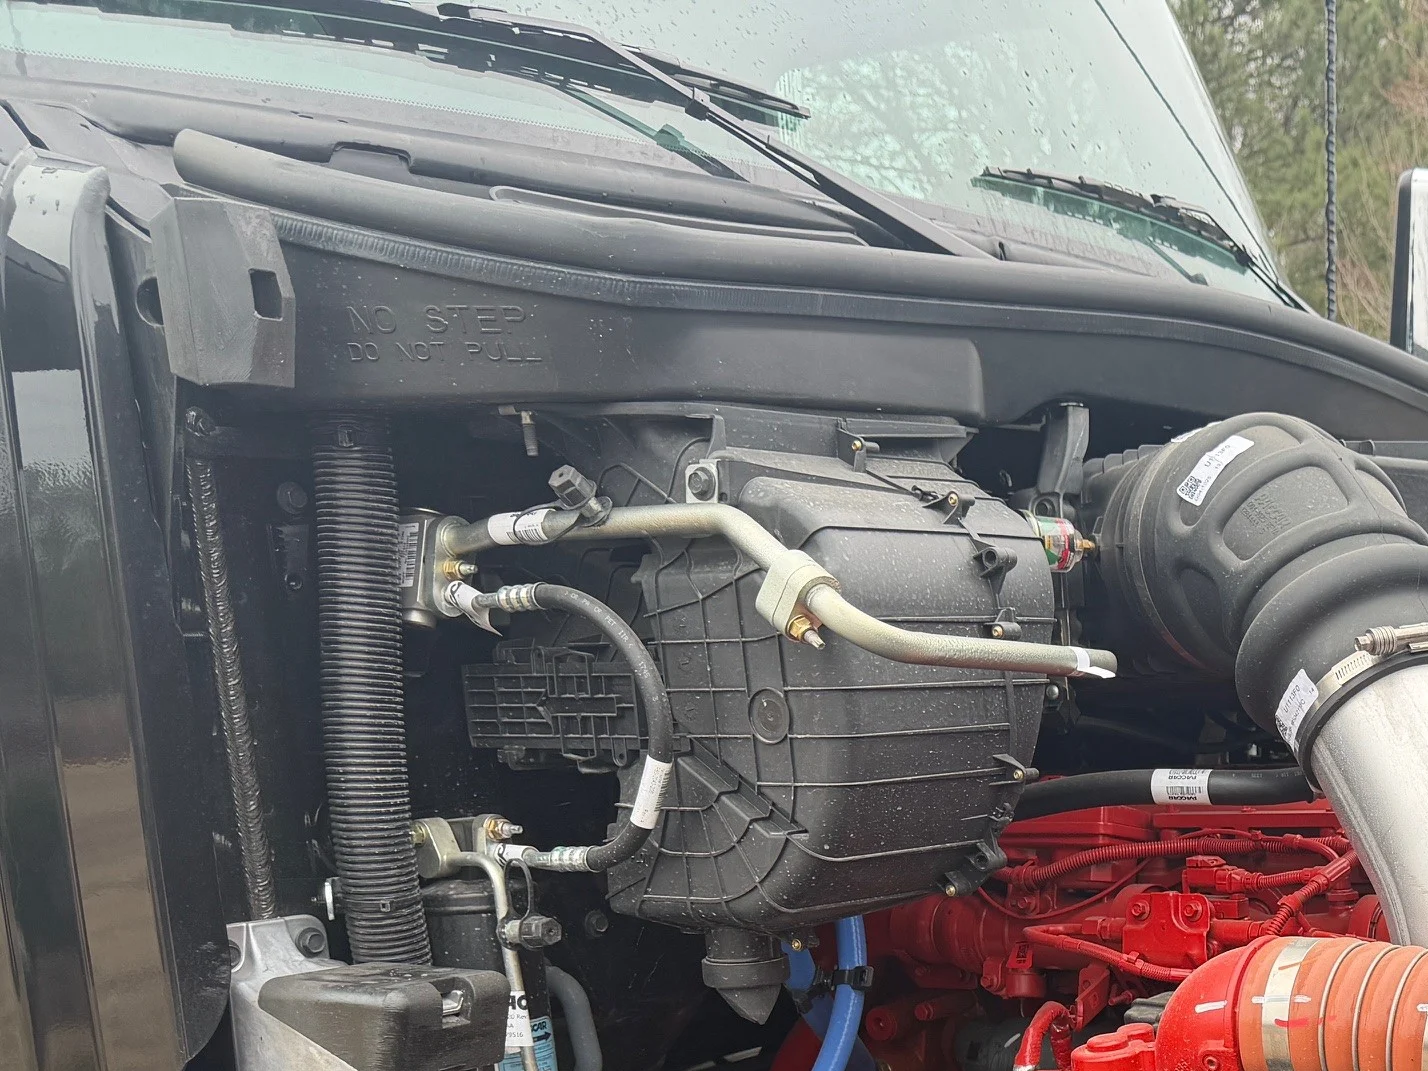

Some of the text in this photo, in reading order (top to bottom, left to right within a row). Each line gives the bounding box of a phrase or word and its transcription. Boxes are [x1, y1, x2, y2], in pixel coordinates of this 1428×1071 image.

[347, 305, 525, 334] NO STEP
[347, 342, 543, 362] DO NOT PULL
